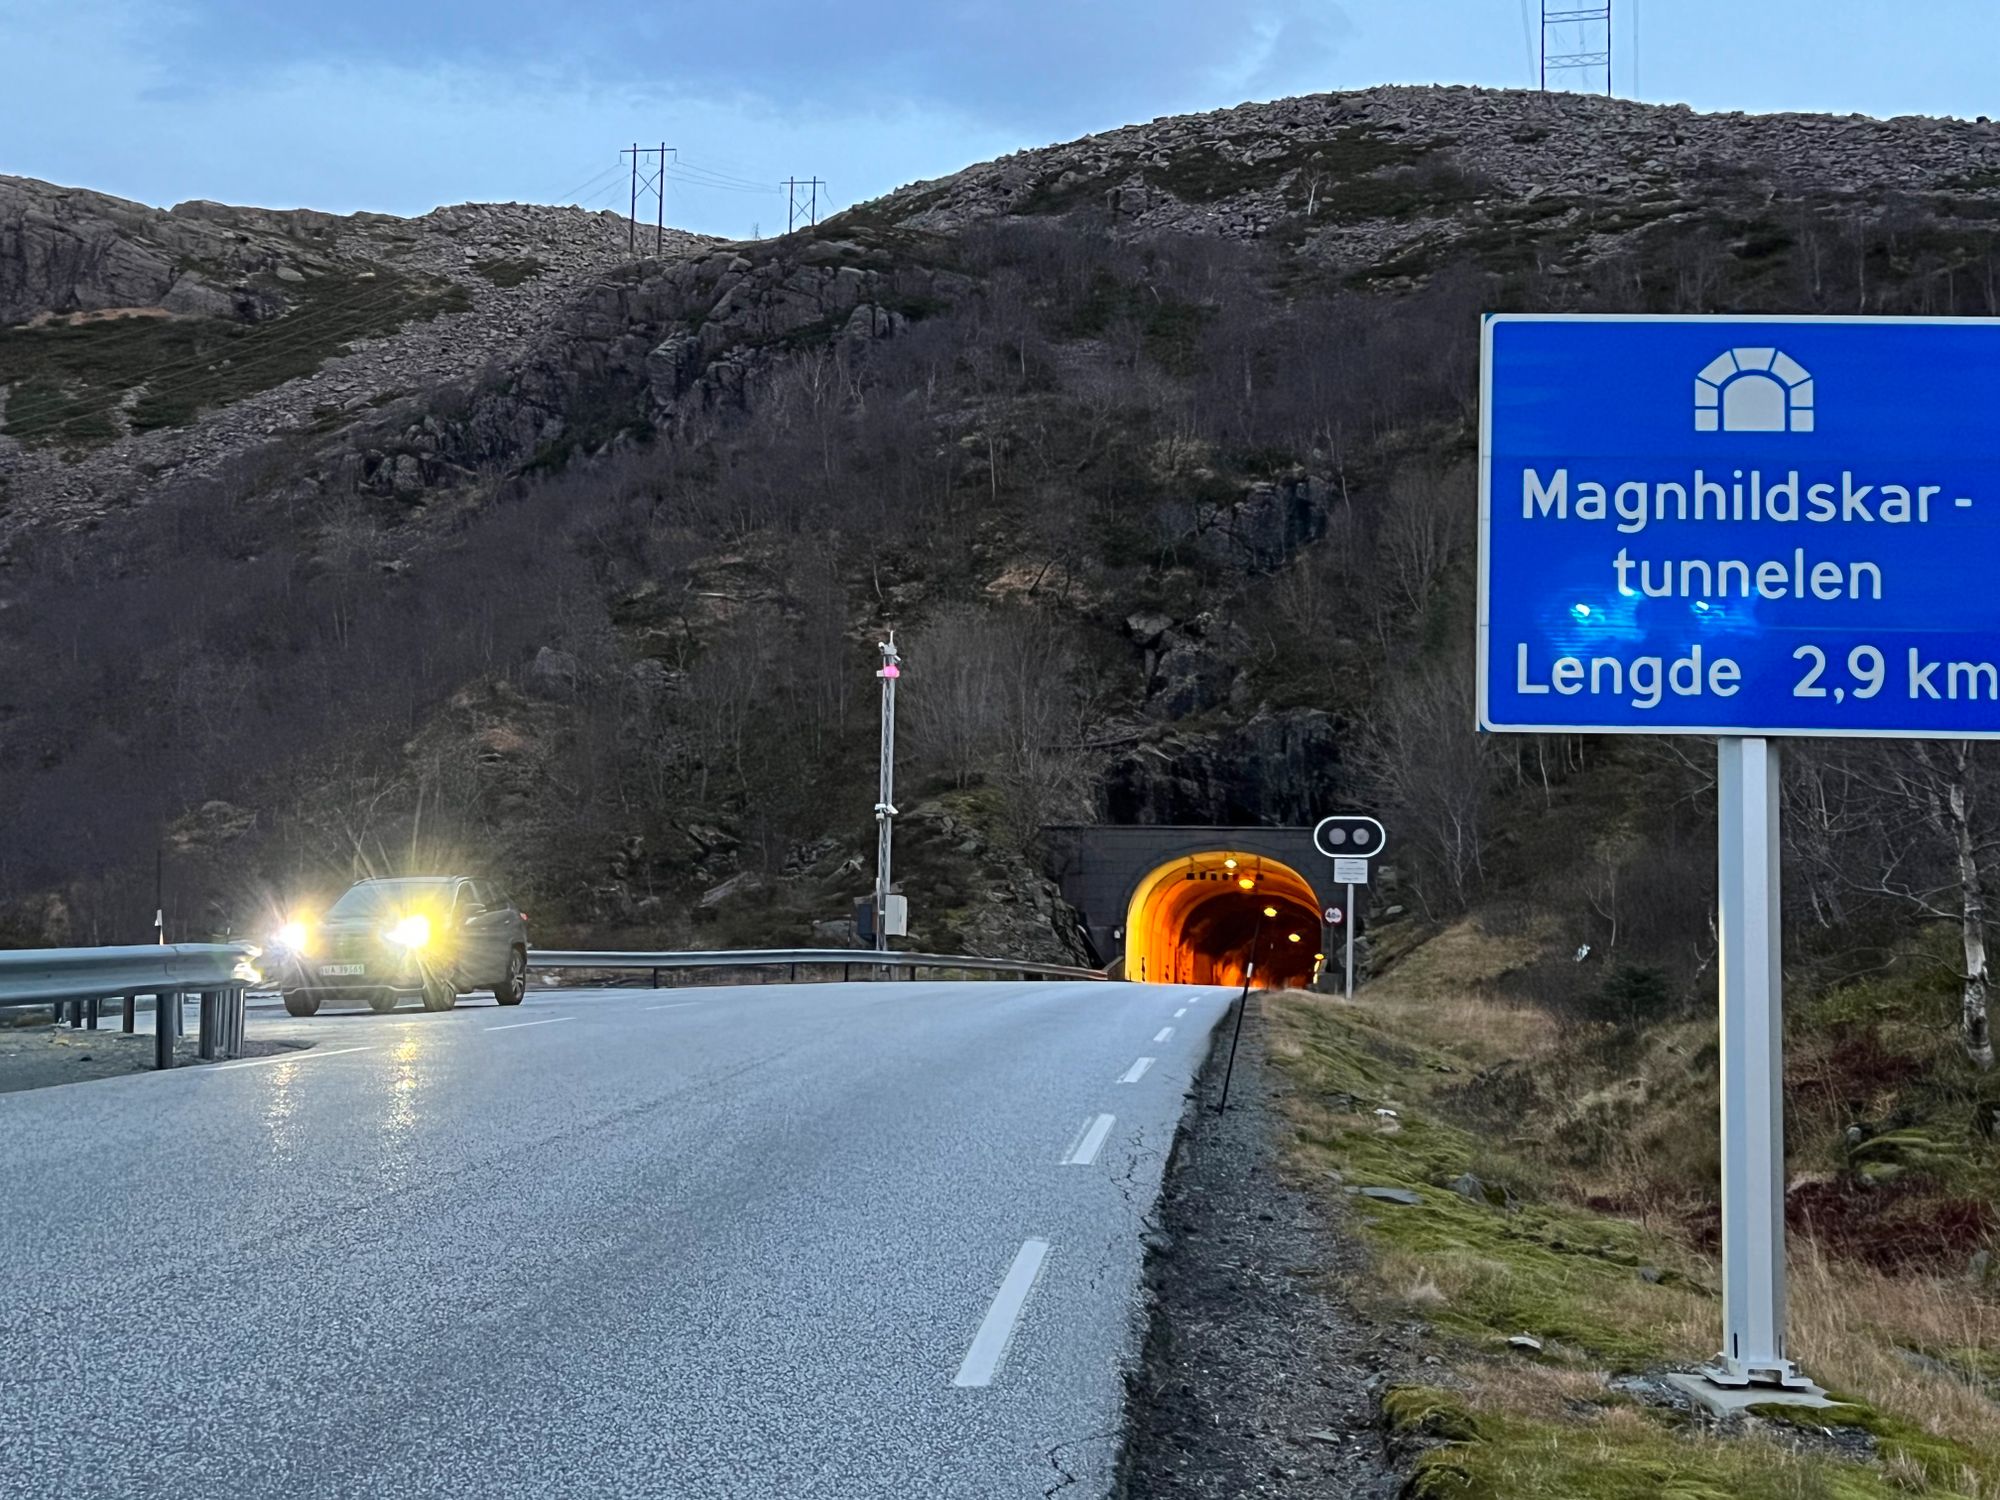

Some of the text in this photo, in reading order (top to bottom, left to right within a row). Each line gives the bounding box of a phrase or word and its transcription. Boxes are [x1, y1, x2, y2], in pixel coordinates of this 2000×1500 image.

[1612, 547, 1882, 600] tunnelen
[1516, 642, 1998, 709] Lengde 2,9 km
